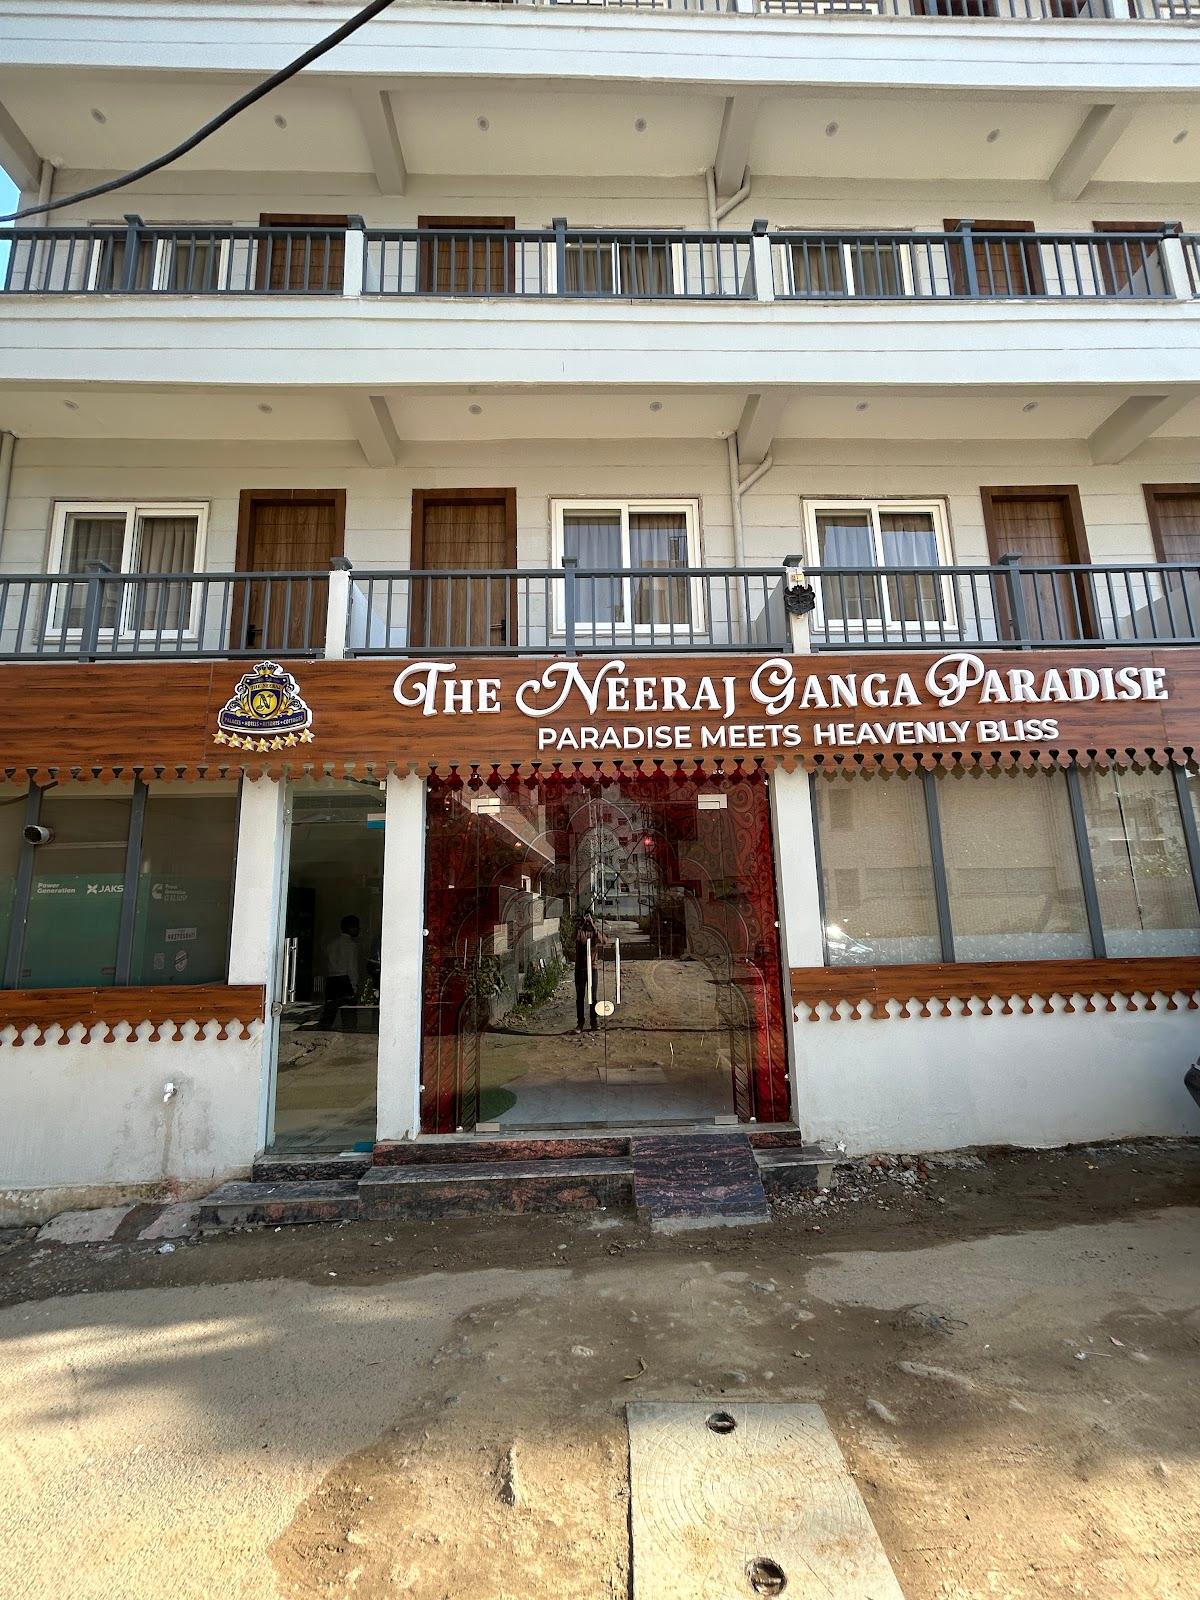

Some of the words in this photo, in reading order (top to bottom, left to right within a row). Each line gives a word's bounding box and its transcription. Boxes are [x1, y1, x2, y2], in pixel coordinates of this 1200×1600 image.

[393, 662, 501, 717] THE
[515, 660, 736, 719] NEERAJ
[750, 657, 923, 717] GANGA
[925, 653, 1169, 708] PARADISE
[538, 725, 693, 750] PARADISE
[701, 723, 802, 749] MEETS
[813, 720, 971, 747] HEAVENLY
[976, 718, 1060, 744] BLISS
[98, 884, 125, 893] JAKS
